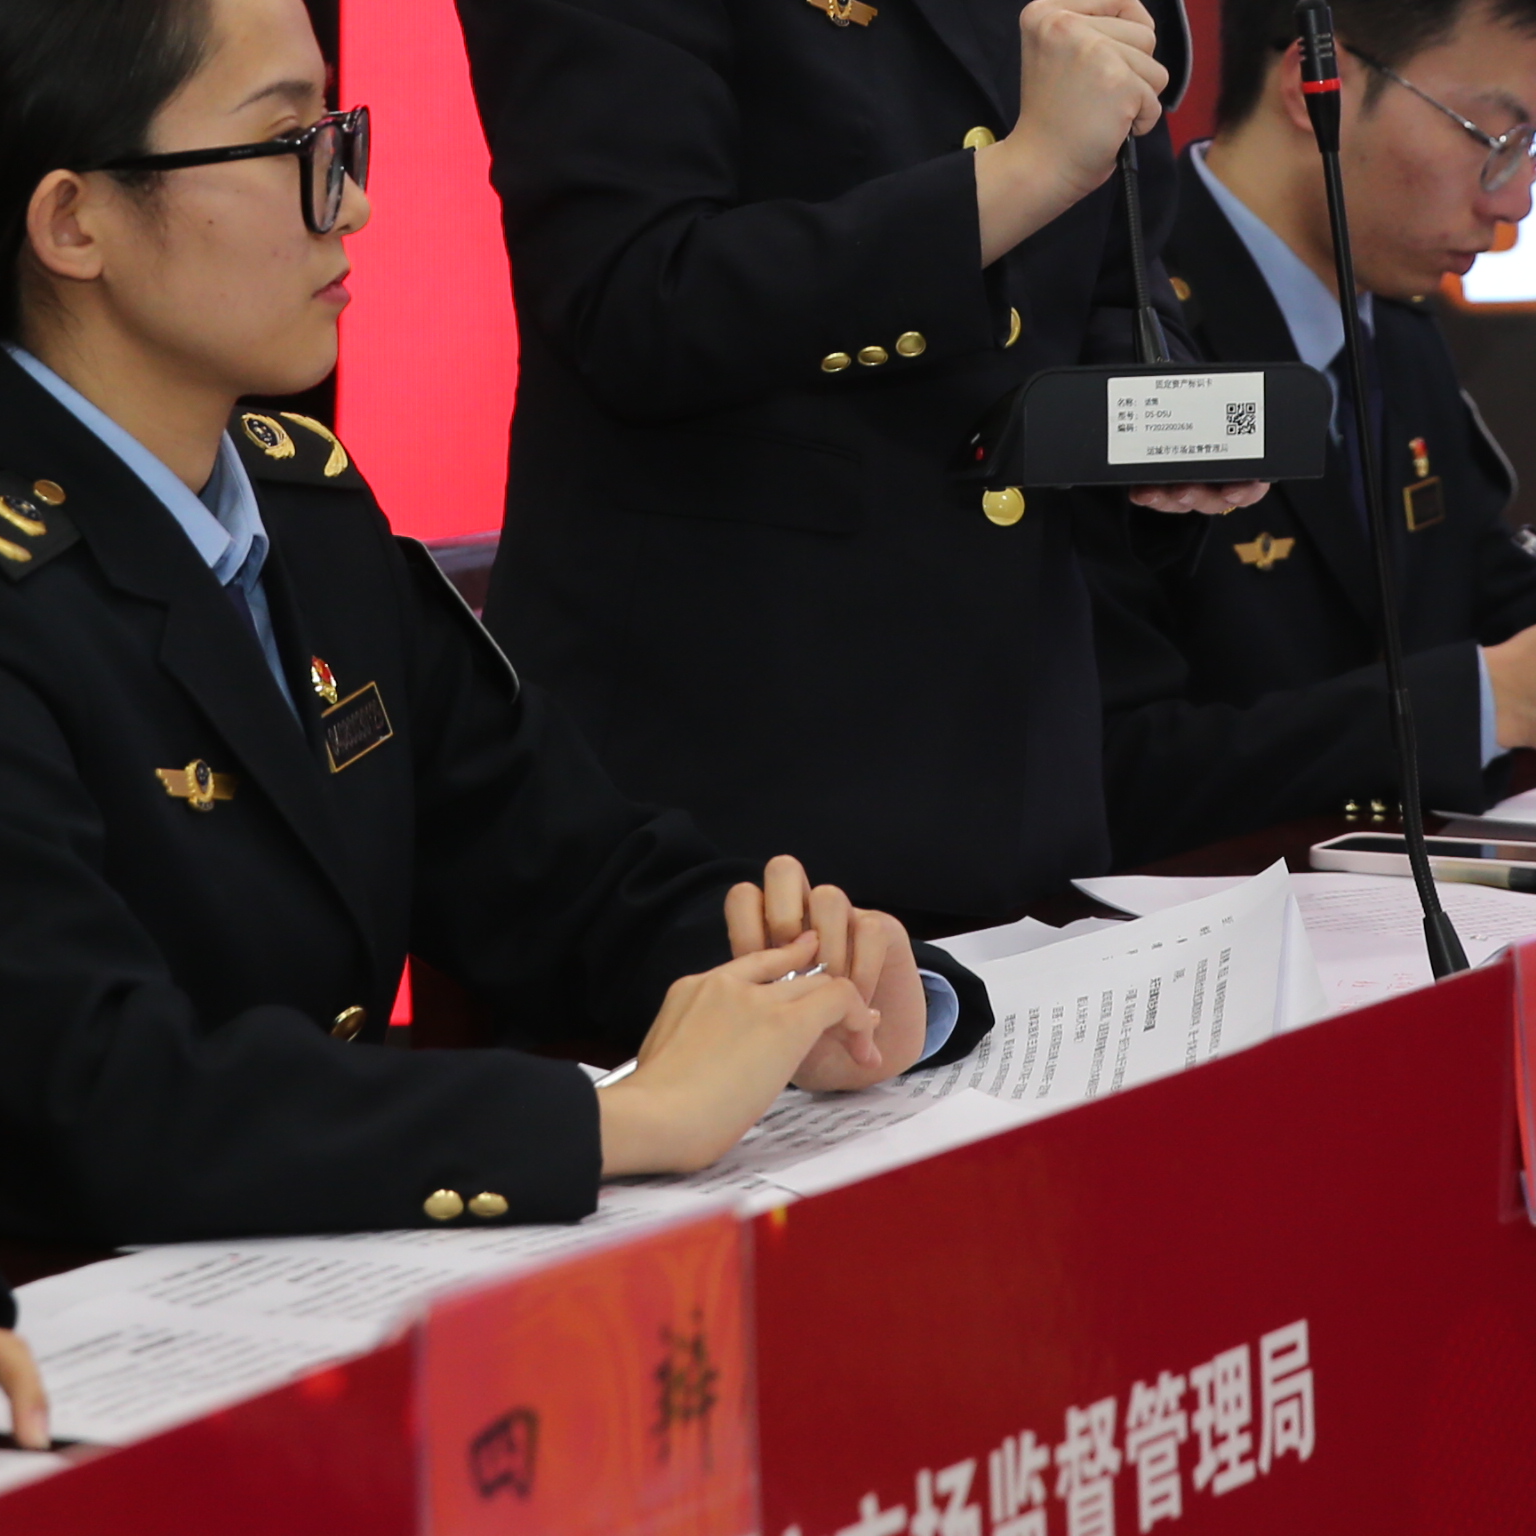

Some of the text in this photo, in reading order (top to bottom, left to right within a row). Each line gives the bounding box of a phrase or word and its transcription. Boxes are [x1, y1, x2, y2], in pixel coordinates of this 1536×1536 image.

[782, 1318, 1316, 1536] 场监督管理局
